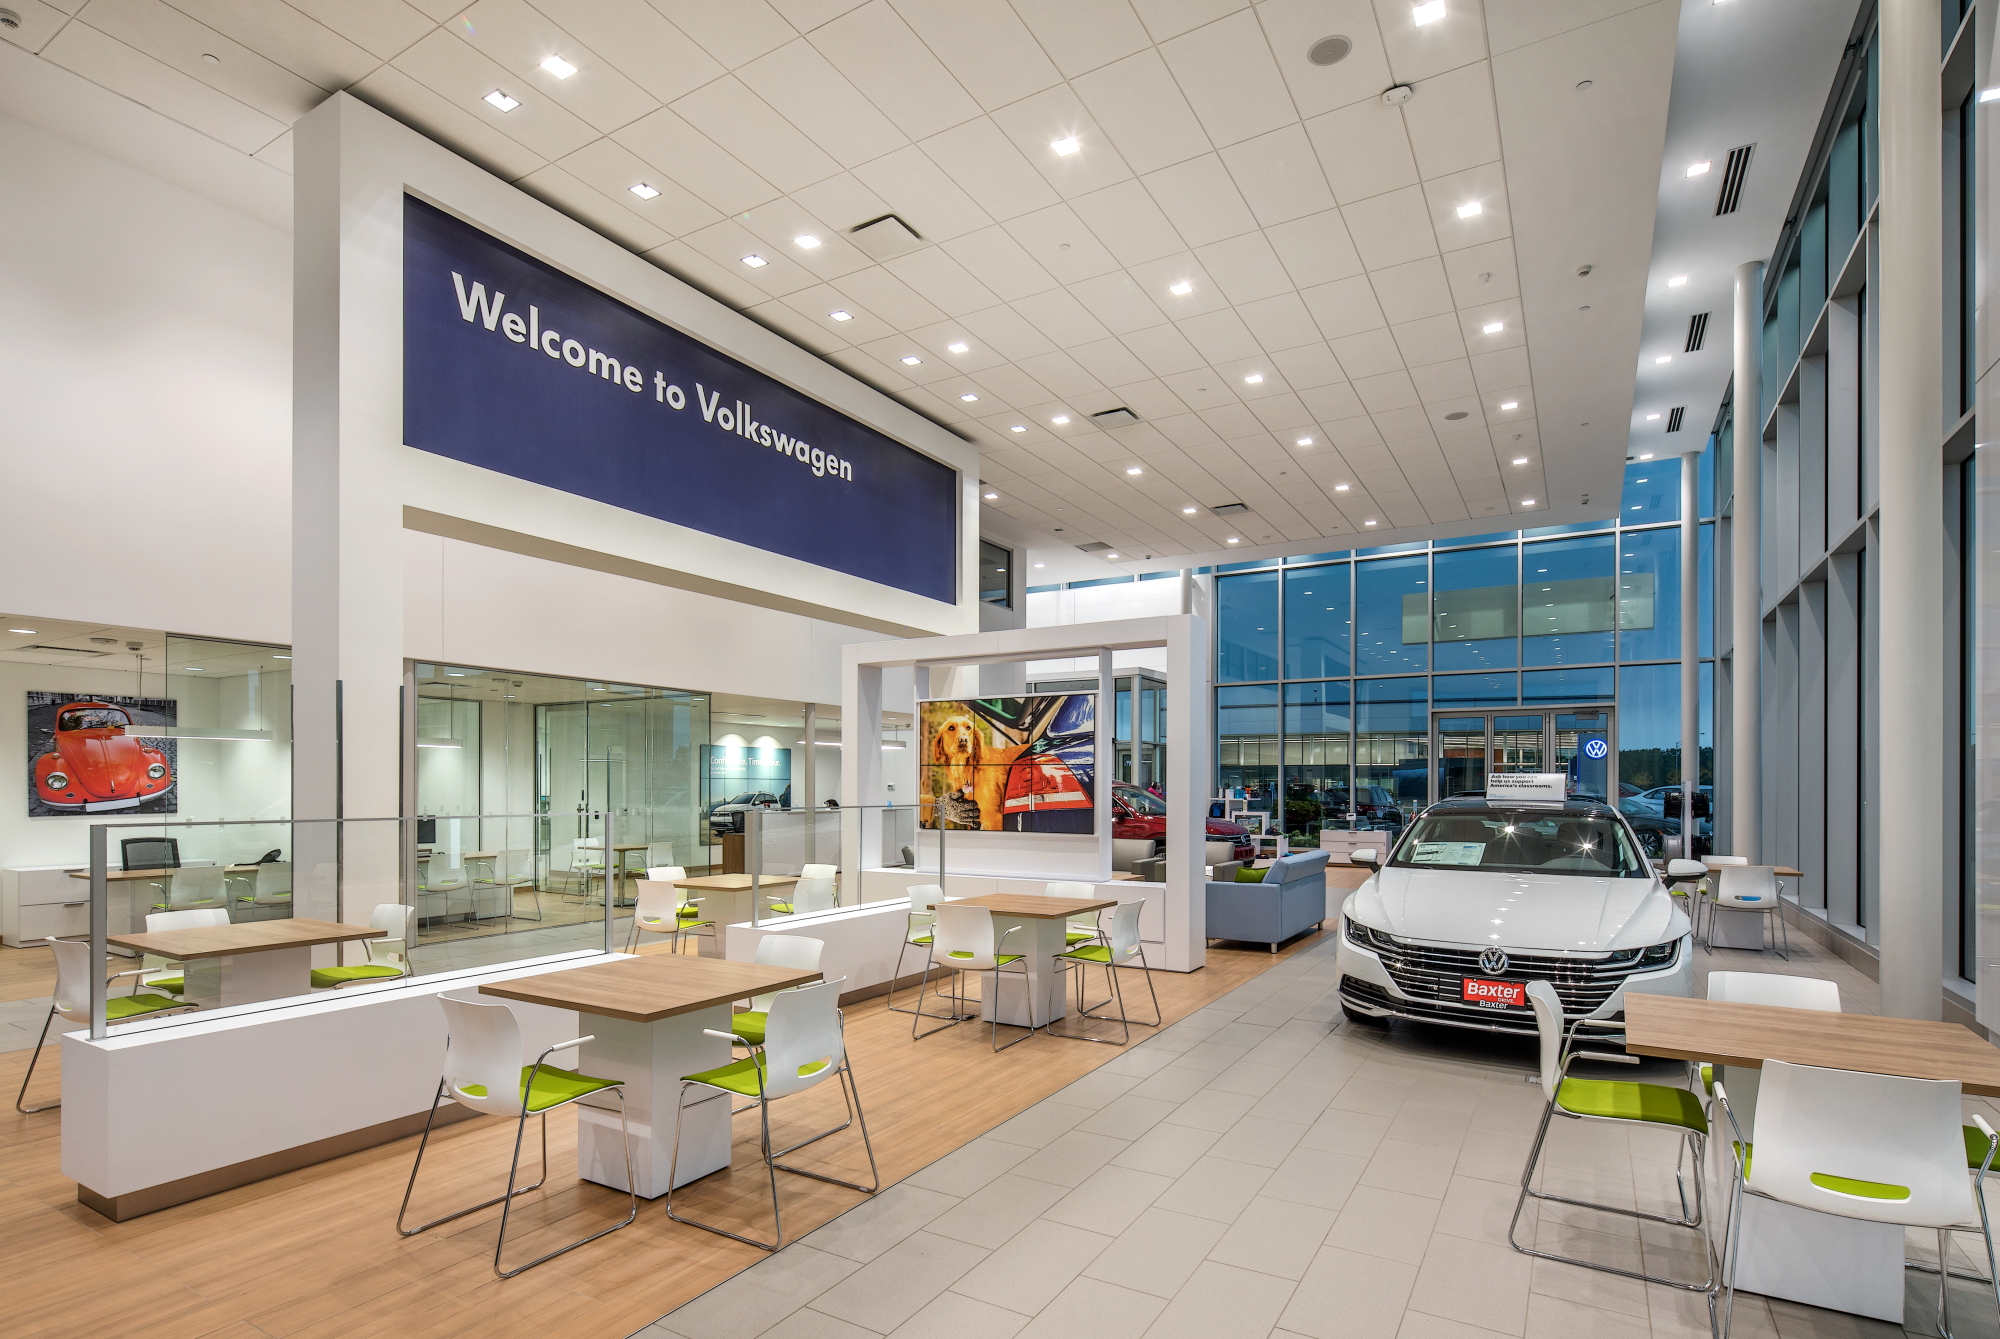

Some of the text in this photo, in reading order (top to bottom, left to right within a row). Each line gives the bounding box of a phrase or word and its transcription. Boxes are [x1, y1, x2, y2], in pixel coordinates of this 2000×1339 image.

[451, 270, 853, 482] Welcome to Volkswagen
[711, 756, 748, 765] Confice.
[1467, 982, 1520, 998] Baxter
[1479, 1000, 1508, 1010] Baxter
